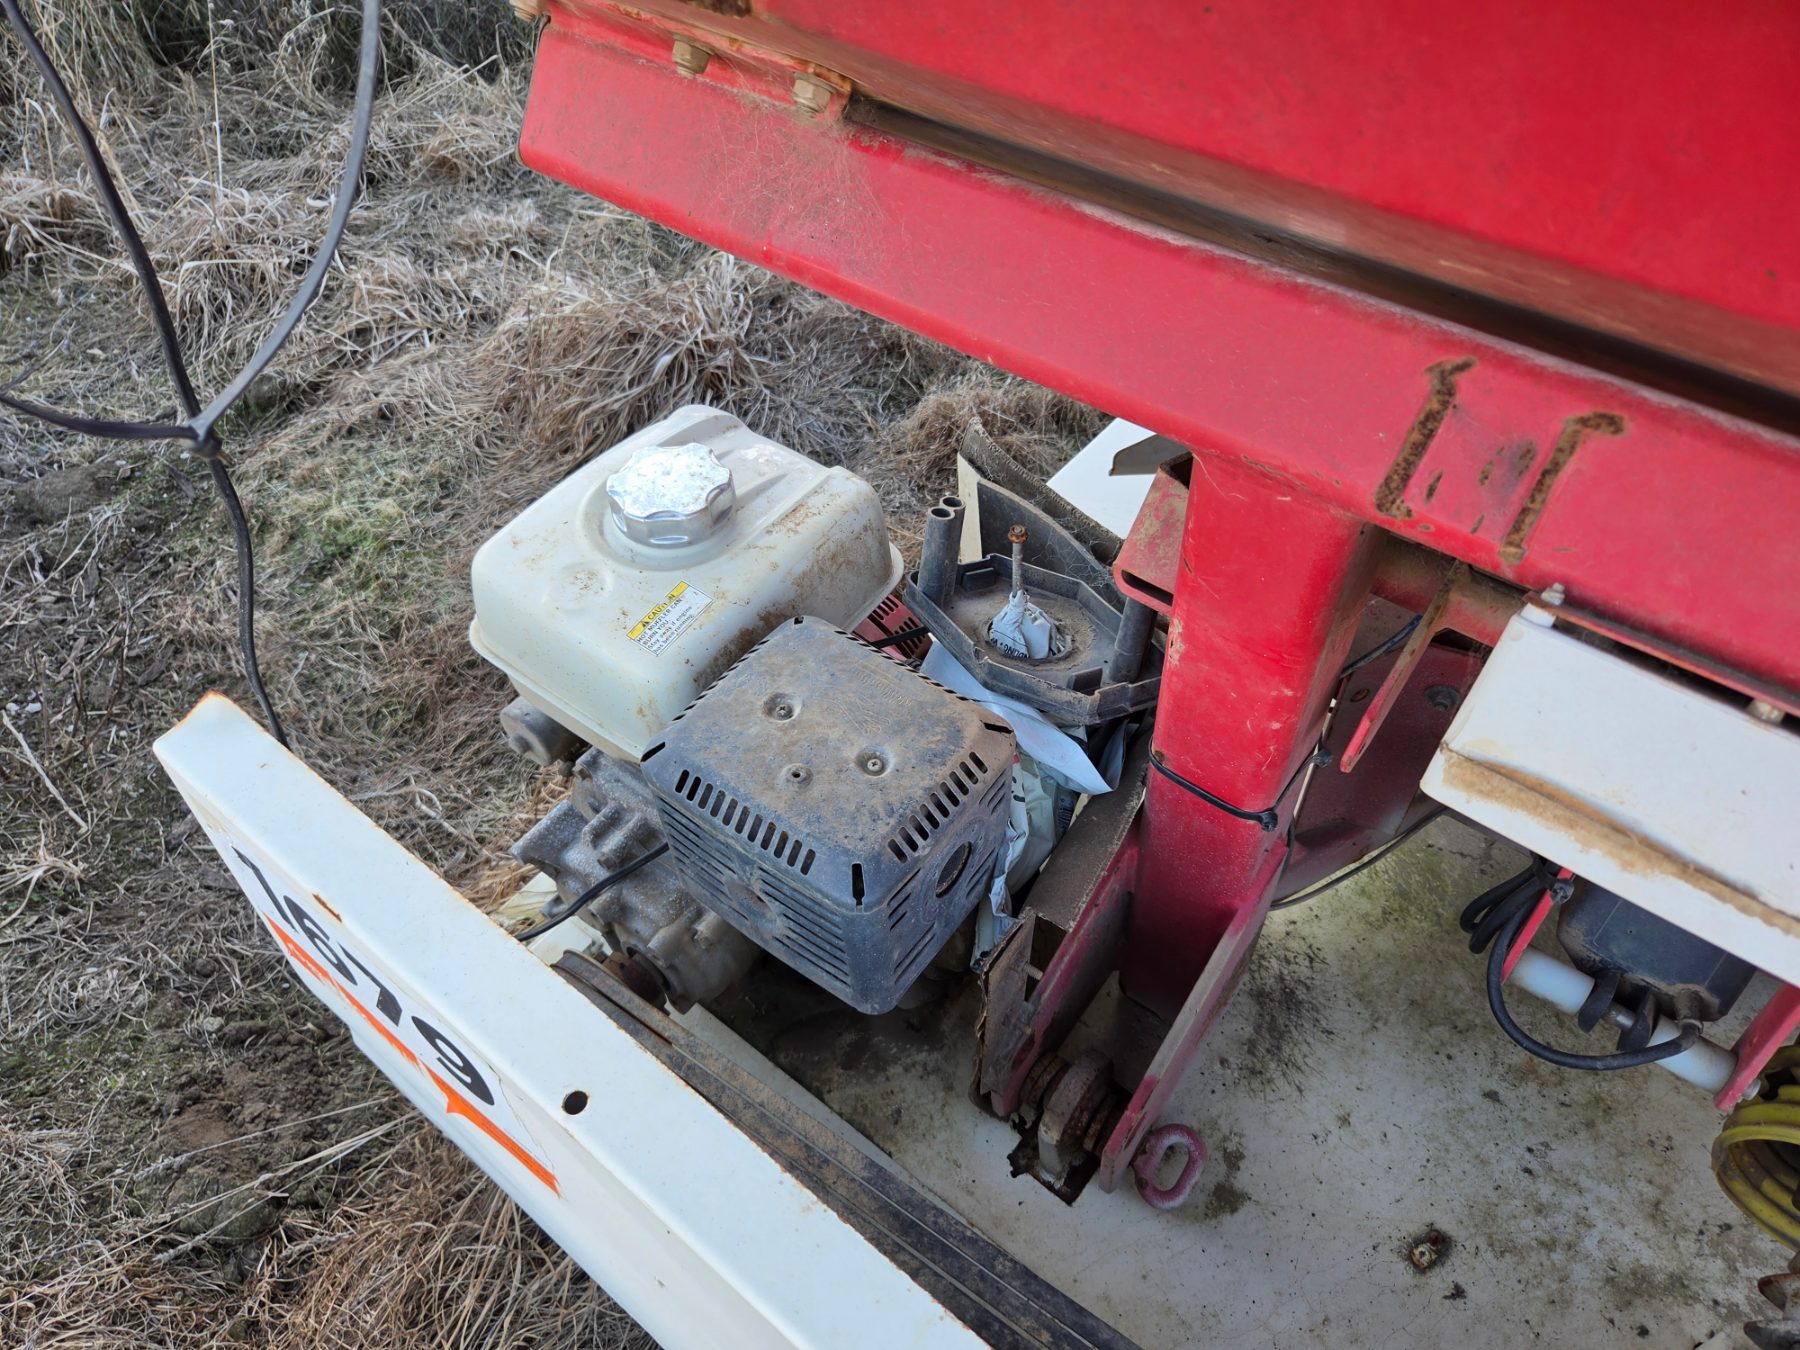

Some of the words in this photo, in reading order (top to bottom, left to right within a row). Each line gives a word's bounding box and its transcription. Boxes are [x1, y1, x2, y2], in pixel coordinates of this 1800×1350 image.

[637, 631, 649, 642] HOT
[647, 608, 672, 632] MUFFLER
[671, 598, 683, 609] CAN
[648, 593, 676, 621] CAUIN
[643, 630, 658, 646] BURN
[647, 637, 660, 649] Stay
[676, 606, 692, 622] engine
[662, 631, 676, 644] been
